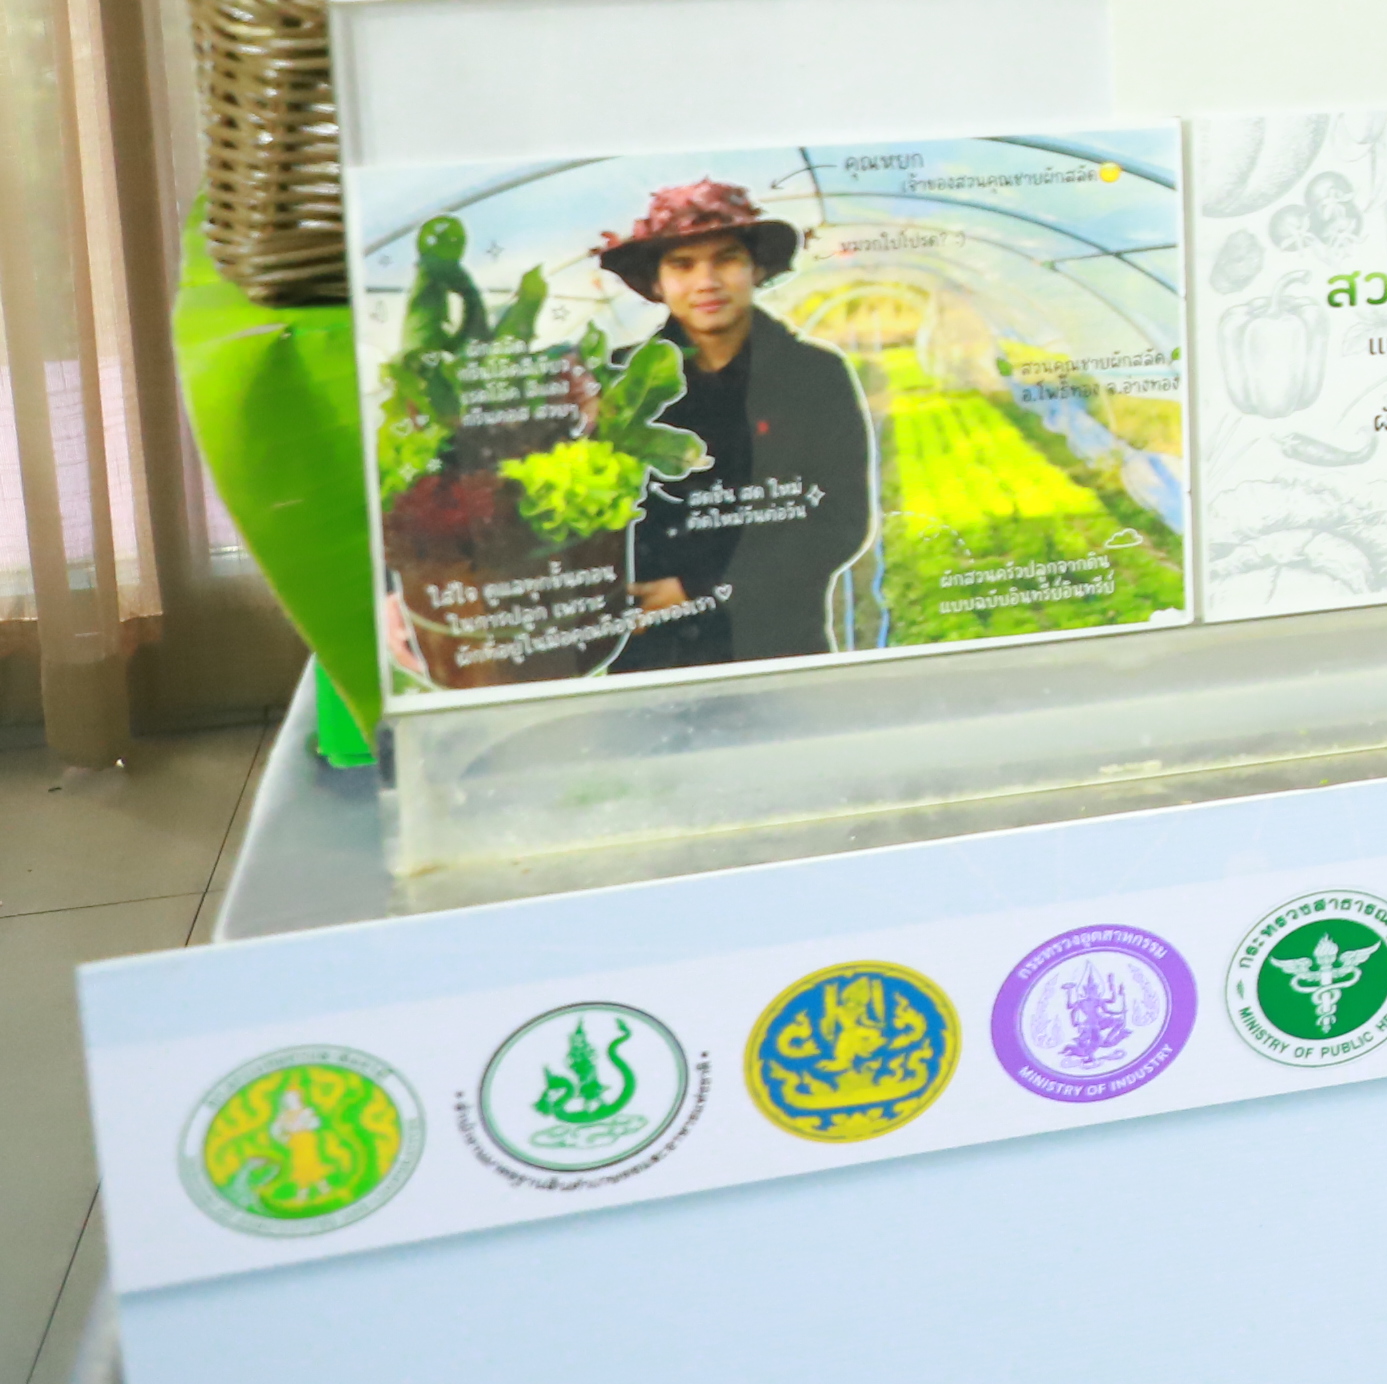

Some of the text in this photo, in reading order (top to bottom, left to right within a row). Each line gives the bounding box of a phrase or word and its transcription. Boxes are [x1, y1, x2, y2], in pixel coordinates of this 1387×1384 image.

[739, 484, 765, 501] สด
[768, 475, 803, 500] ใหม่
[1238, 1006, 1292, 1054] MINISTRY
[1293, 1046, 1315, 1059] OF
[1320, 1031, 1375, 1059] PUBLIC
[1018, 1043, 1175, 1097] MINISTRY OF INDUSTRY
